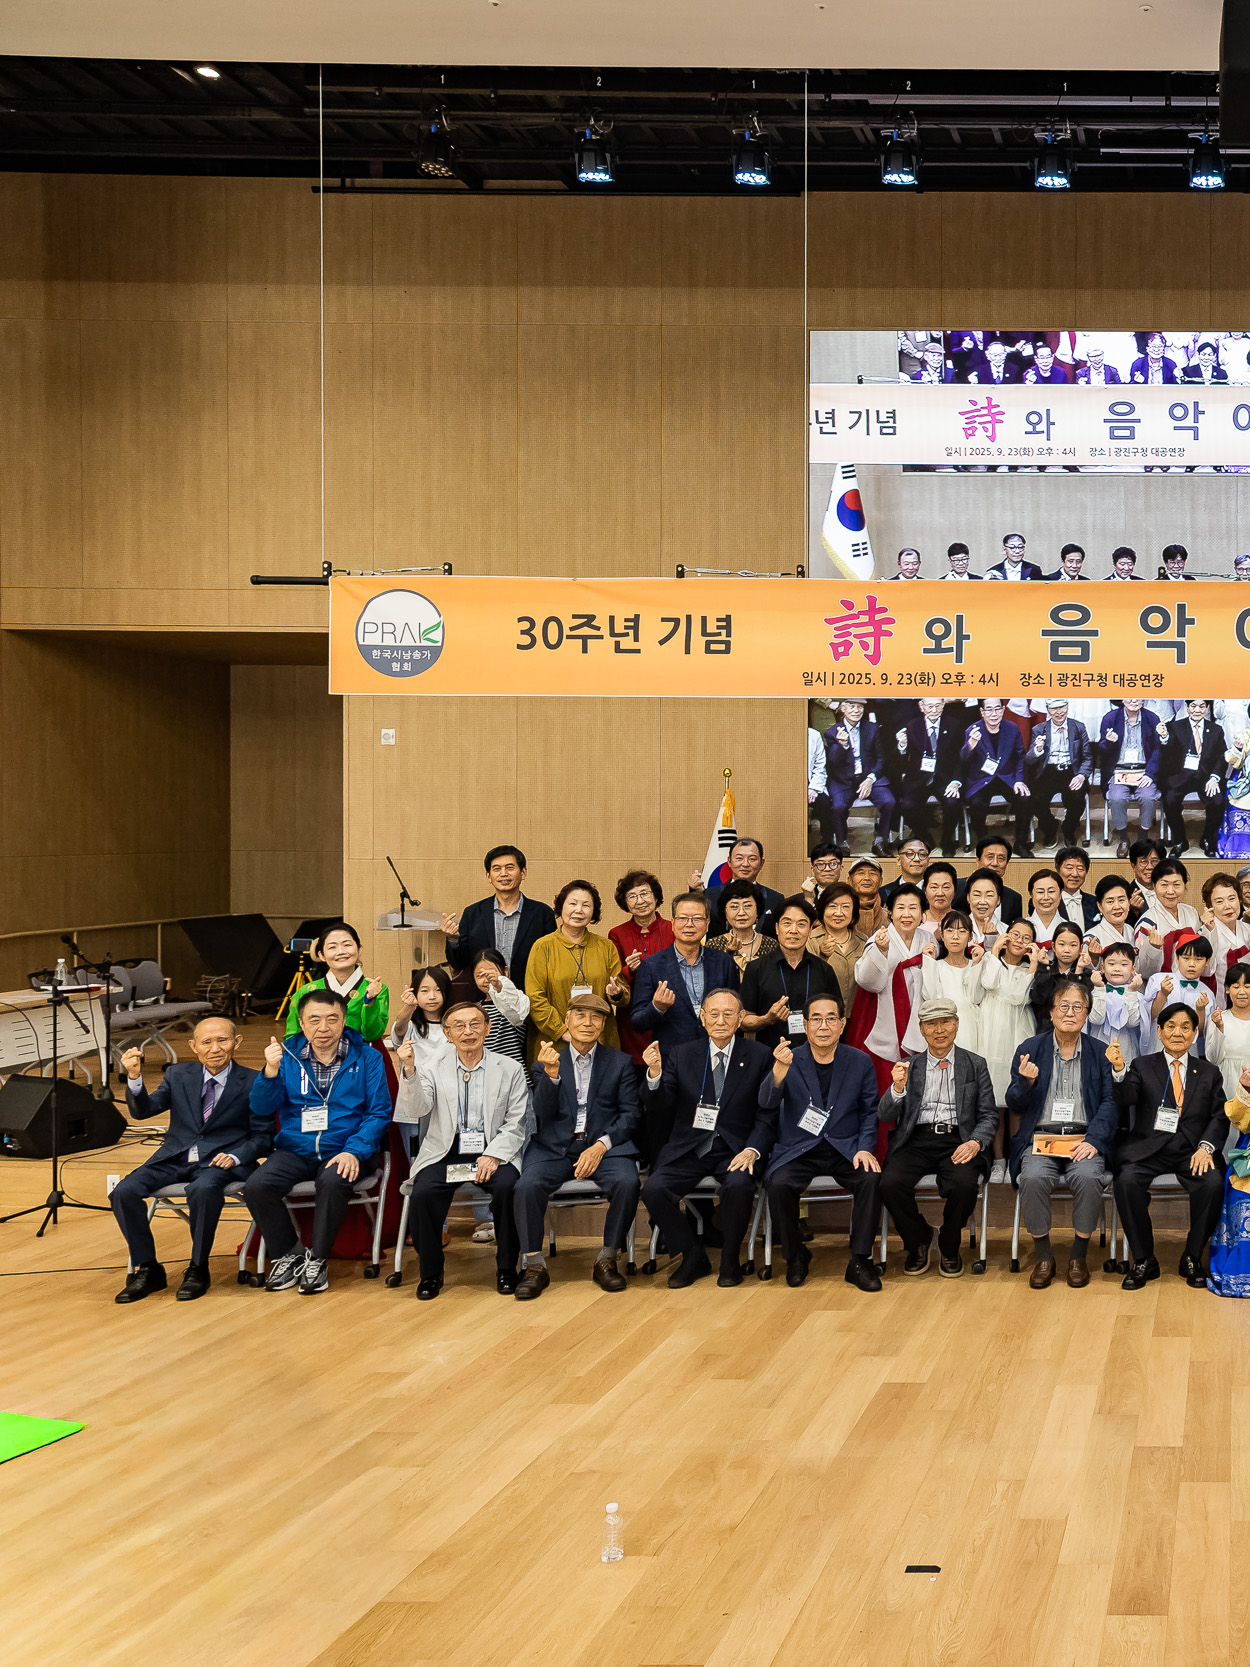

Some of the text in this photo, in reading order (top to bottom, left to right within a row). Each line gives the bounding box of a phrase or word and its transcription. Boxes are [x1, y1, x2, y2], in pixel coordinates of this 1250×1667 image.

[440, 75, 445, 85] 1
[597, 76, 603, 86] 2
[751, 79, 756, 89] 1
[906, 80, 912, 90] 2
[1063, 82, 1068, 91] 1
[848, 408, 897, 436] 기념
[945, 446, 962, 457] 일시
[1061, 447, 1076, 457] 4시
[516, 613, 642, 655] 30주년
[657, 613, 733, 655] 기념
[371, 648, 432, 661] 한국시낭송가
[390, 661, 412, 673] 협회
[802, 671, 827, 687] 일시
[838, 672, 877, 686] 2025.
[880, 672, 893, 686] 9.
[896, 671, 936, 688] 23(화)
[940, 671, 967, 687] 오후
[978, 672, 999, 687] 4시
[1019, 672, 1046, 688] 장소
[1056, 672, 1108, 688] 광진구청
[1112, 673, 1165, 688] 대공연장
